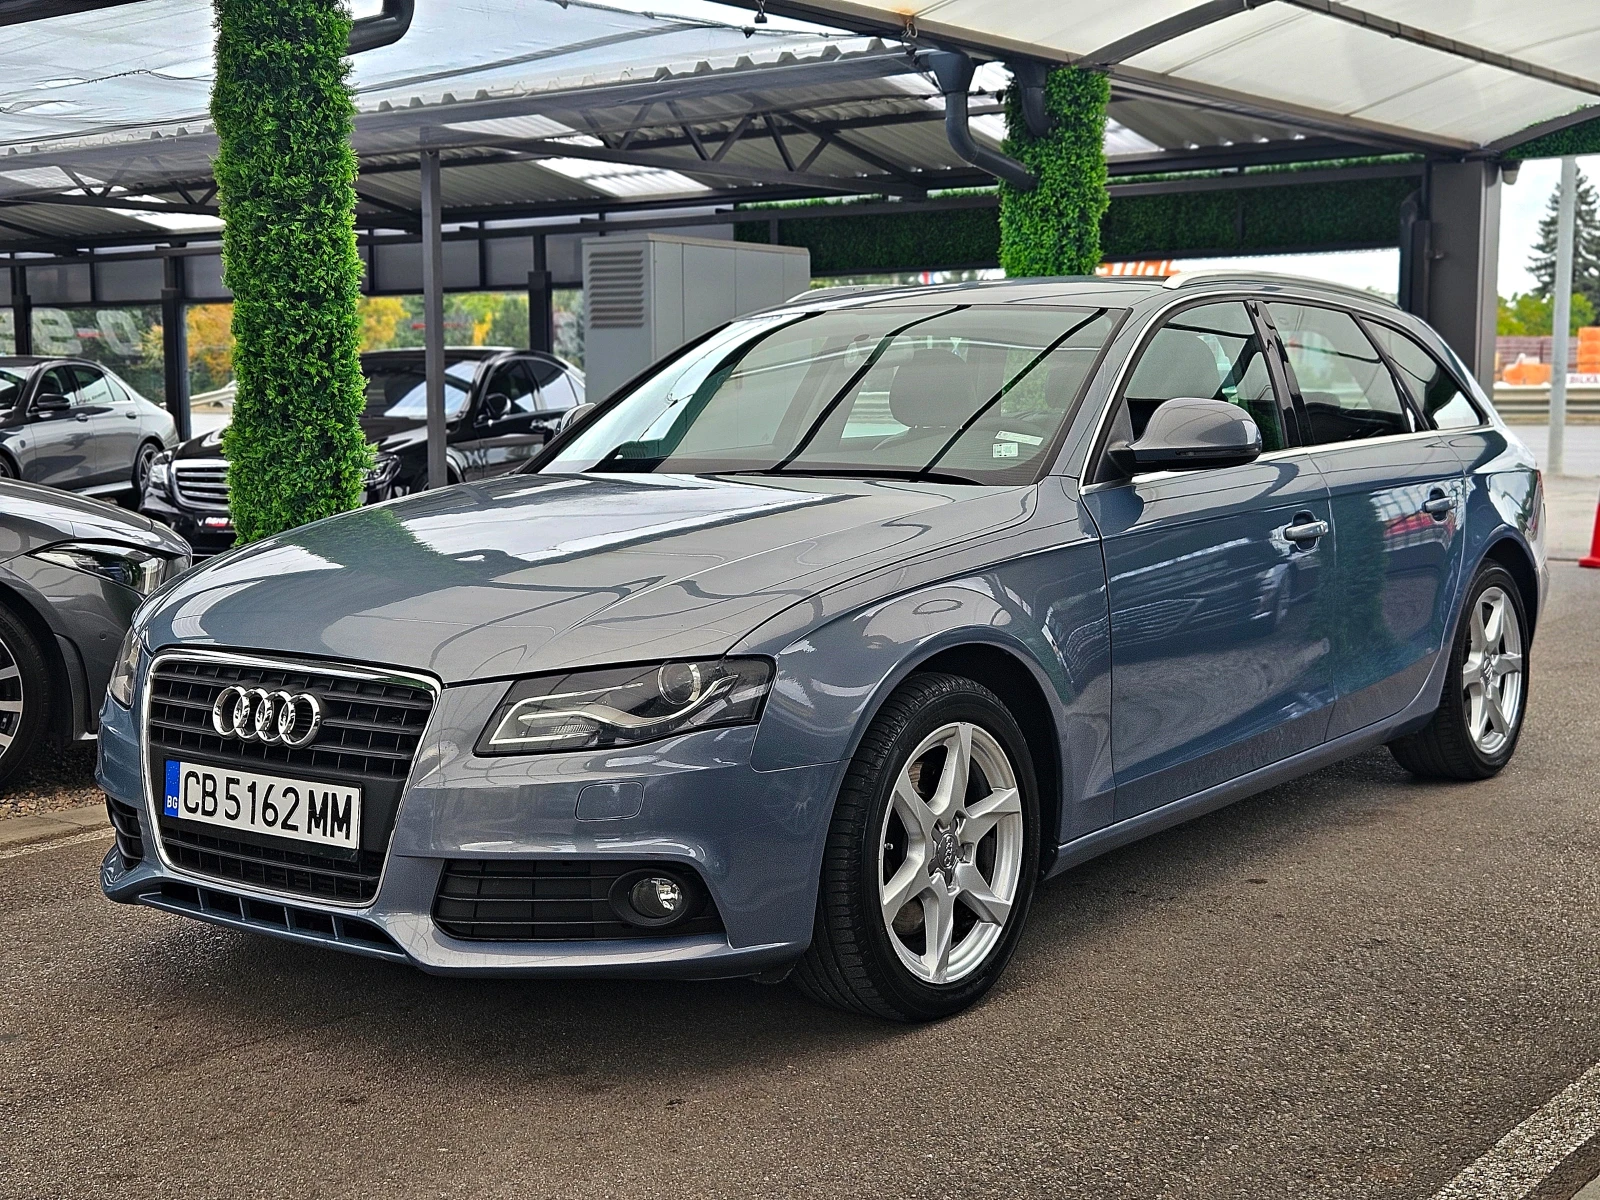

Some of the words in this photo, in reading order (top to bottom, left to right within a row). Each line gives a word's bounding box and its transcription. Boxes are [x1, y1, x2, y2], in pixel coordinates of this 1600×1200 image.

[166, 795, 178, 809] BG
[183, 770, 218, 816] CB
[224, 776, 300, 832] 5162
[306, 789, 352, 840] MM
